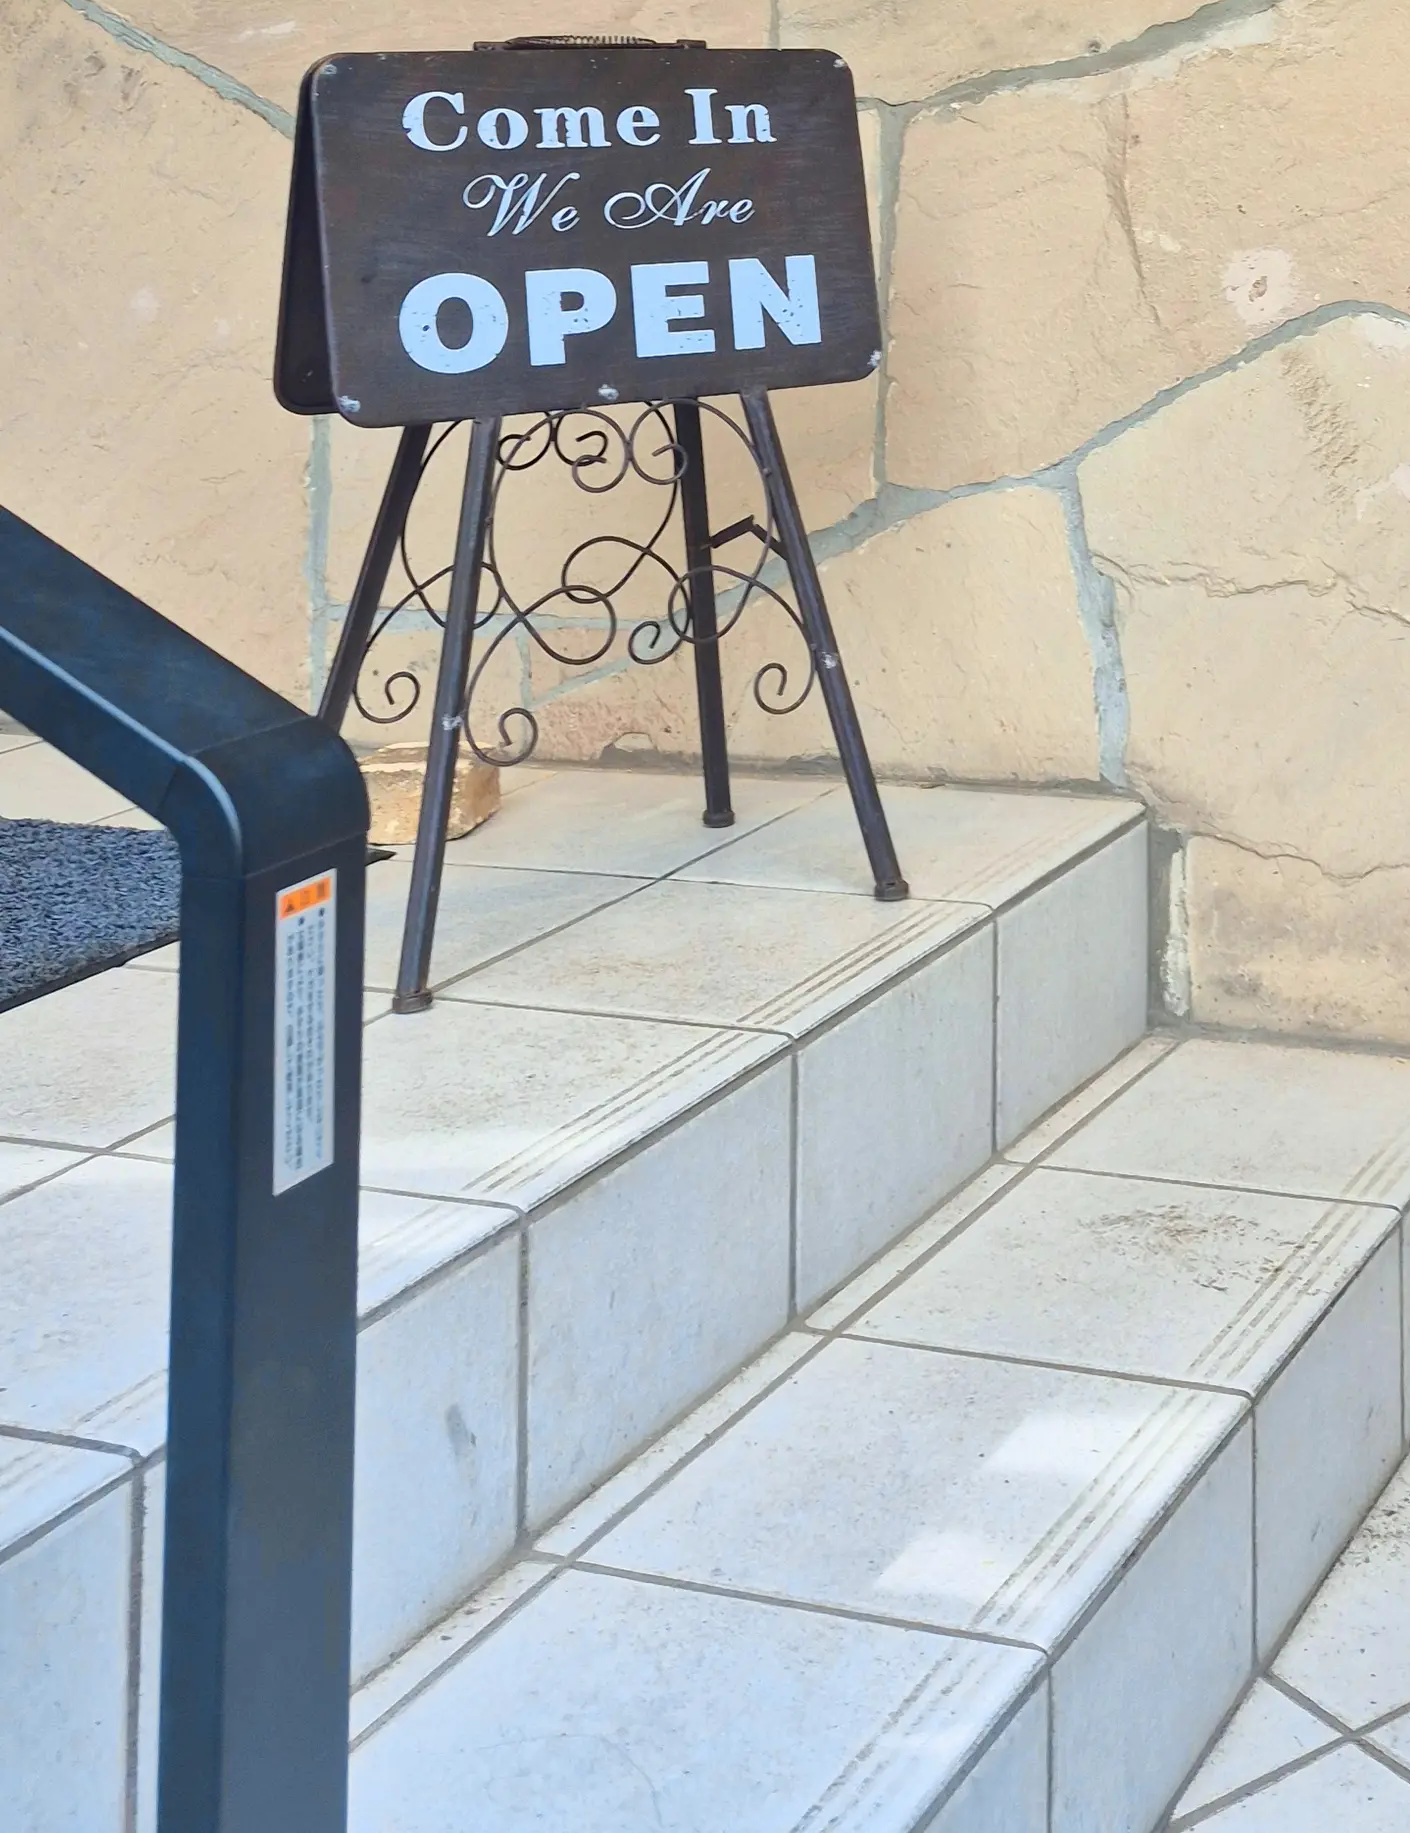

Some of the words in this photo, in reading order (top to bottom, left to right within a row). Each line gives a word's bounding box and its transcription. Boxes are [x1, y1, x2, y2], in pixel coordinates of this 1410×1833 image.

[401, 90, 662, 152] Come
[684, 87, 778, 145] In
[462, 171, 581, 237] We
[603, 167, 757, 230] Are
[398, 254, 822, 374] OPEN
